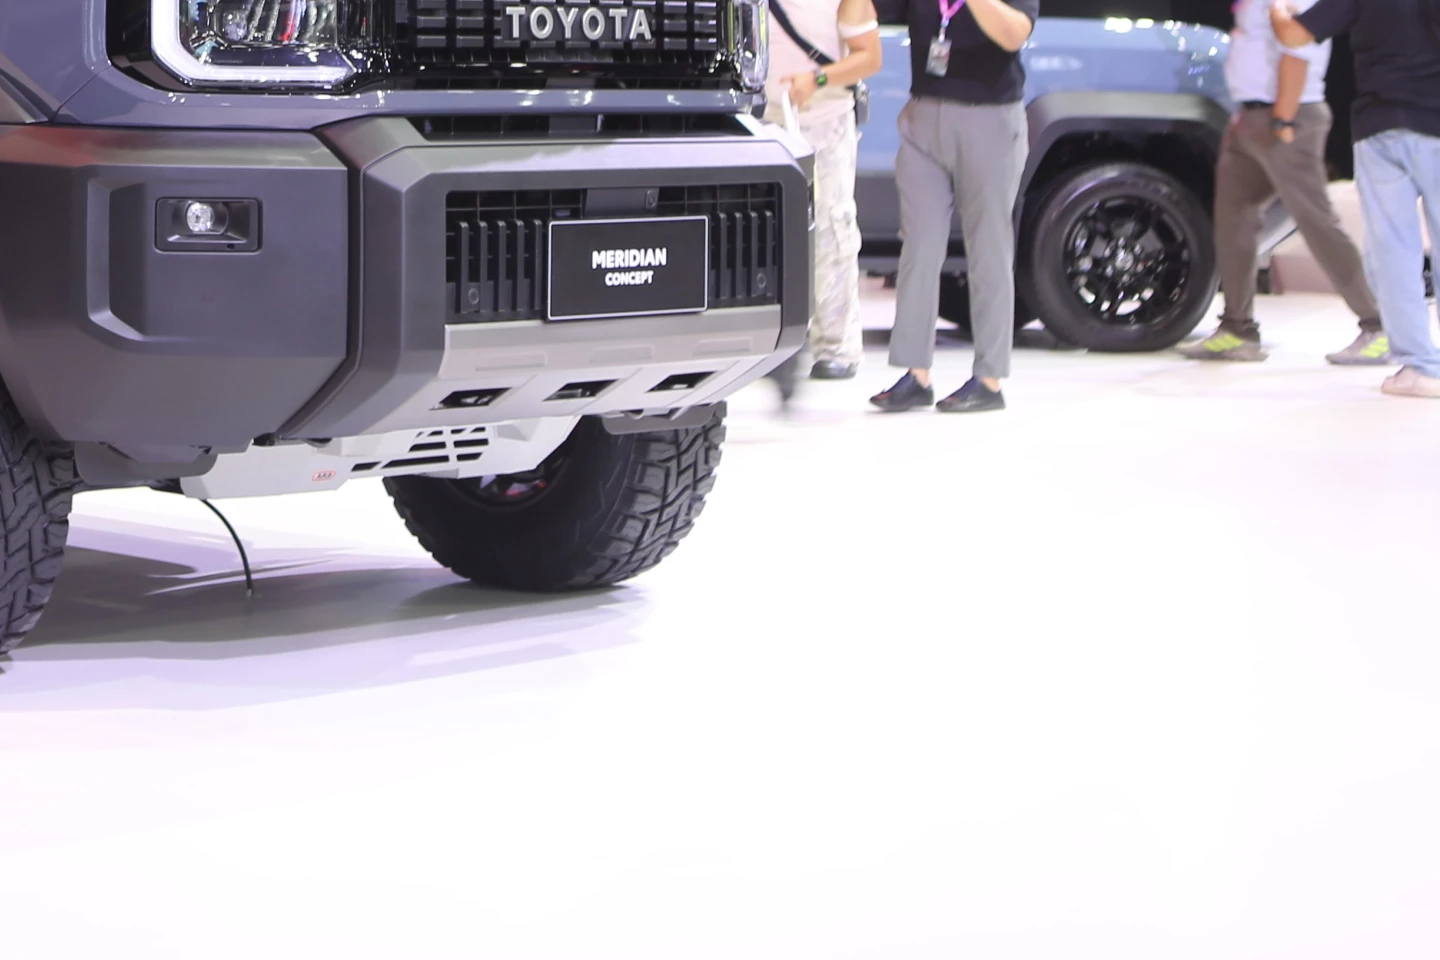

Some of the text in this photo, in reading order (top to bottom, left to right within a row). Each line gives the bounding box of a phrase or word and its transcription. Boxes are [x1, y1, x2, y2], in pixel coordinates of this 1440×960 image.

[506, 6, 653, 40] TOYOTA
[591, 247, 667, 270] MERIDIAN
[604, 270, 654, 286] CONCEPT
